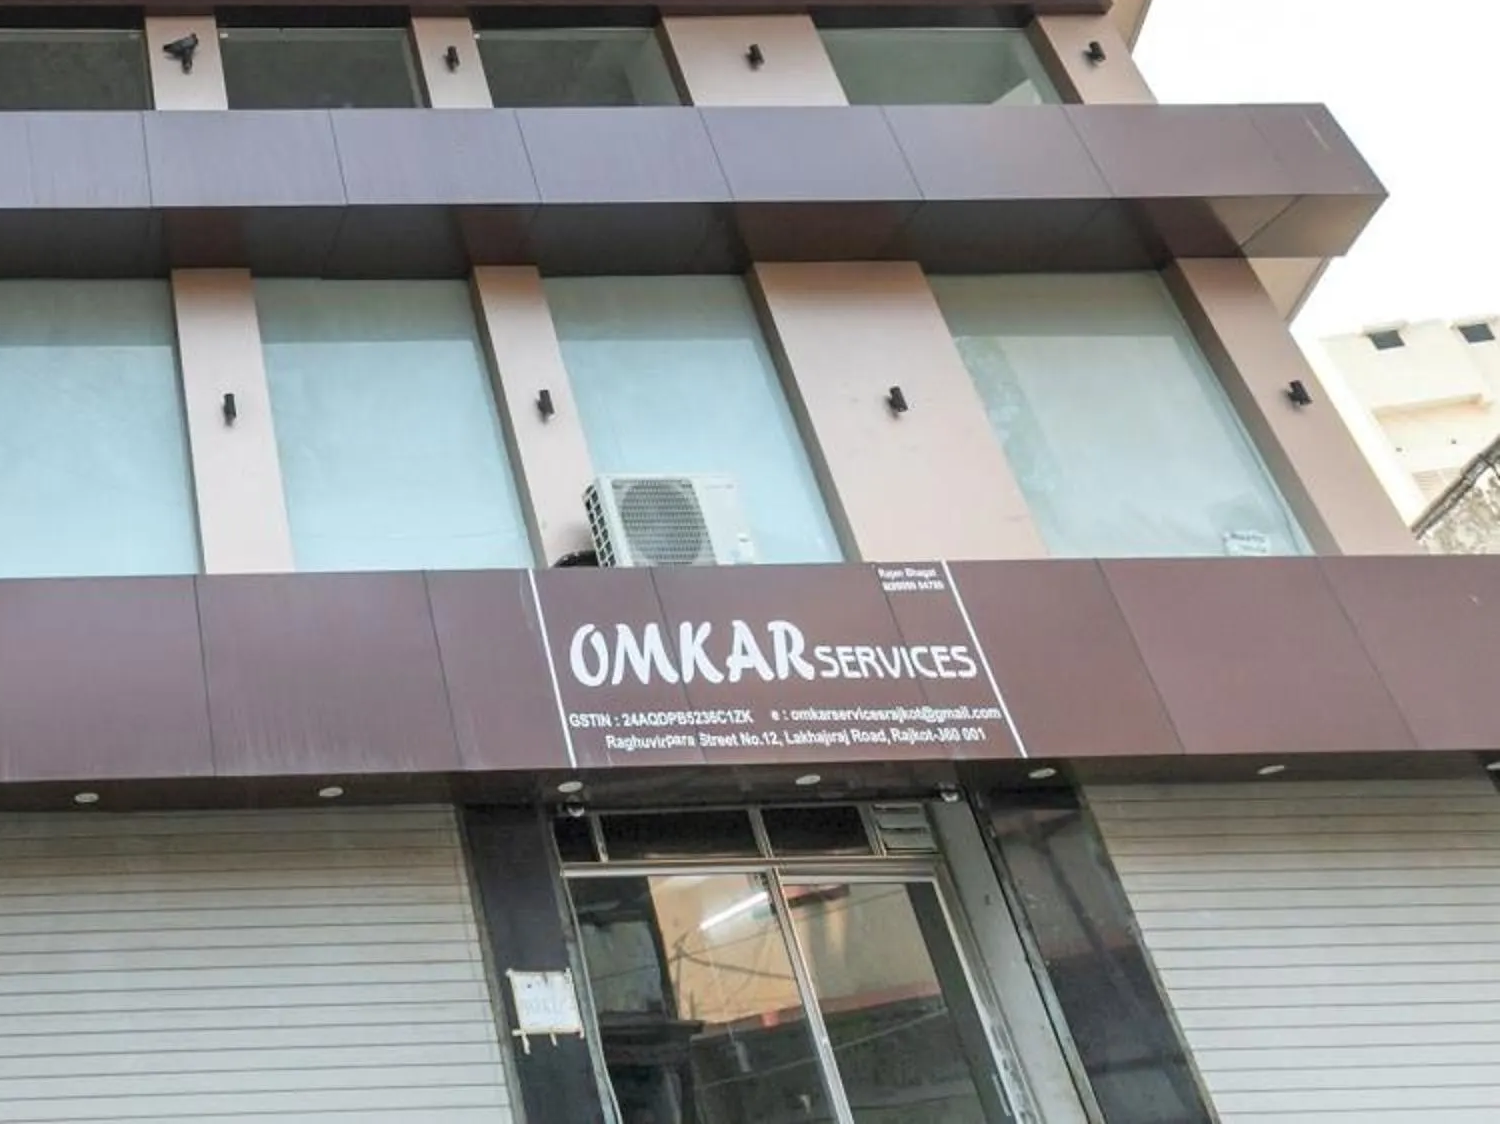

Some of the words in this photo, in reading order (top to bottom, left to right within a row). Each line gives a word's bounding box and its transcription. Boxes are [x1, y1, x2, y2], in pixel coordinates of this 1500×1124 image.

[569, 619, 815, 687] OMKAR
[813, 644, 978, 679] SERVICES
[569, 712, 612, 728] GSTIN
[698, 731, 739, 747] Street
[849, 727, 891, 746] Road,
